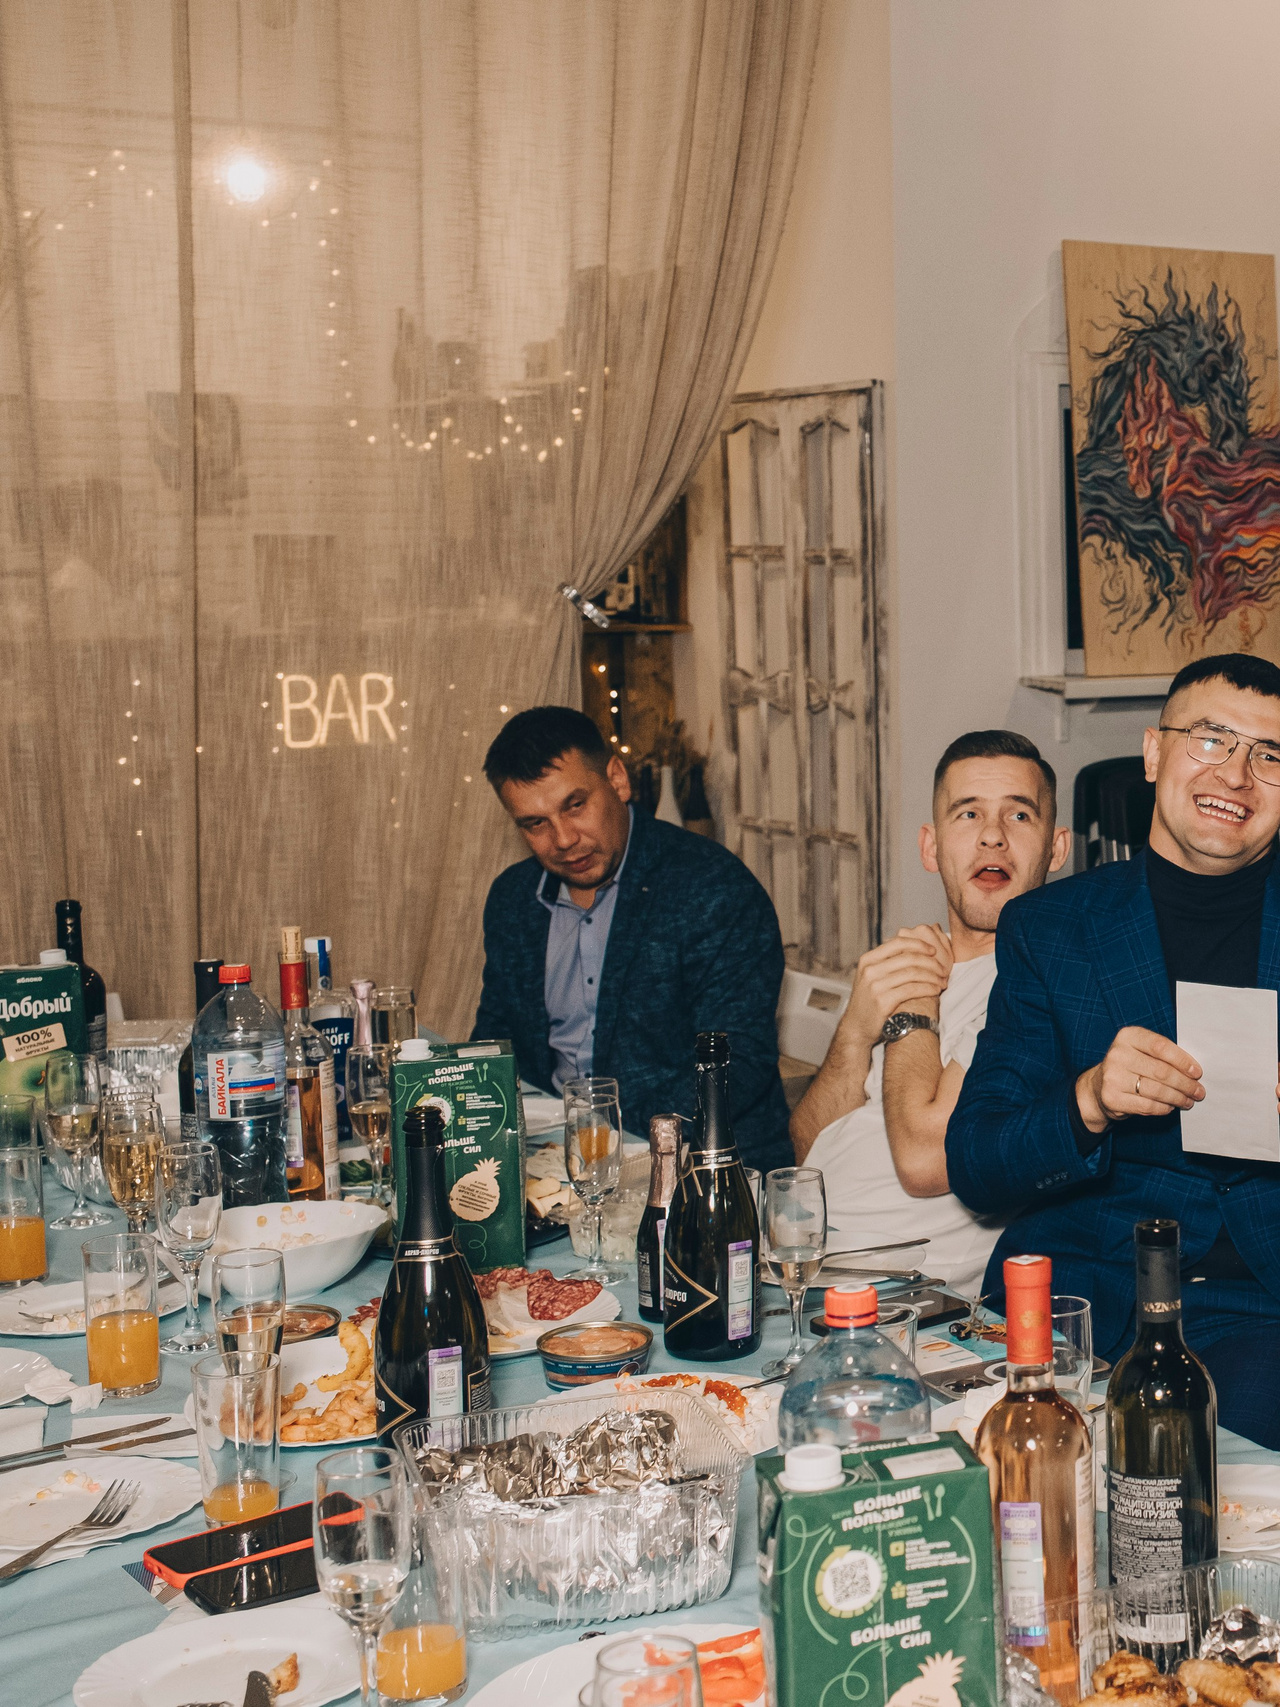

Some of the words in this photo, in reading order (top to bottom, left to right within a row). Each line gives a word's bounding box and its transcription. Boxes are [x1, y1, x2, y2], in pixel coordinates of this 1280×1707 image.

[282, 672, 397, 748] BAR
[0, 991, 72, 1022] Добрый
[15, 1028, 52, 1046] 100%
[434, 1062, 475, 1077] БОЛЬШЕ
[427, 1073, 465, 1086] ПОЛЬЗЫ
[463, 1144, 482, 1154] СИЛ
[853, 1485, 922, 1515] БОЛЬШЕ
[1155, 1499, 1183, 1510] РЕГИОН
[841, 1505, 905, 1532] ПОЛЬЗЫ
[1114, 1503, 1142, 1518] КАХЕТИЯ
[850, 1614, 923, 1647] БОЛЬШЕ
[900, 1630, 931, 1649] СИЛ
